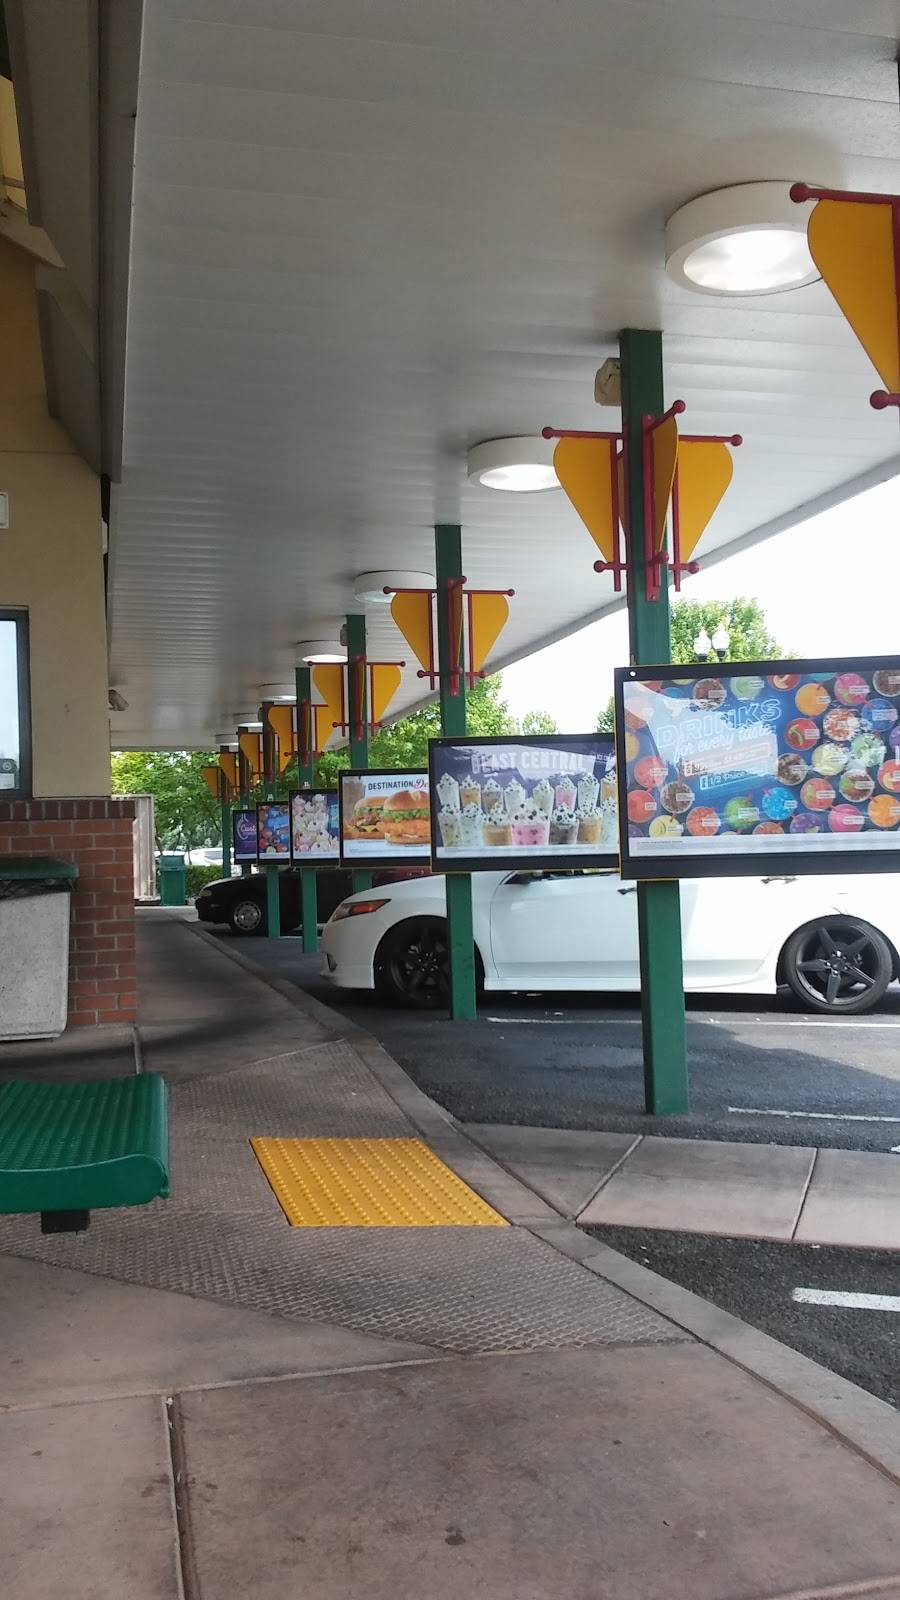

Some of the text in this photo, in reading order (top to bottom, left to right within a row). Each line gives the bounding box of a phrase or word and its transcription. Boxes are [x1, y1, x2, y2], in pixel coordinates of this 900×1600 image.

[656, 698, 782, 749] DRINKS
[697, 732, 735, 751] every
[520, 750, 583, 770] CENTRAL
[368, 780, 413, 791] DESTINATION
